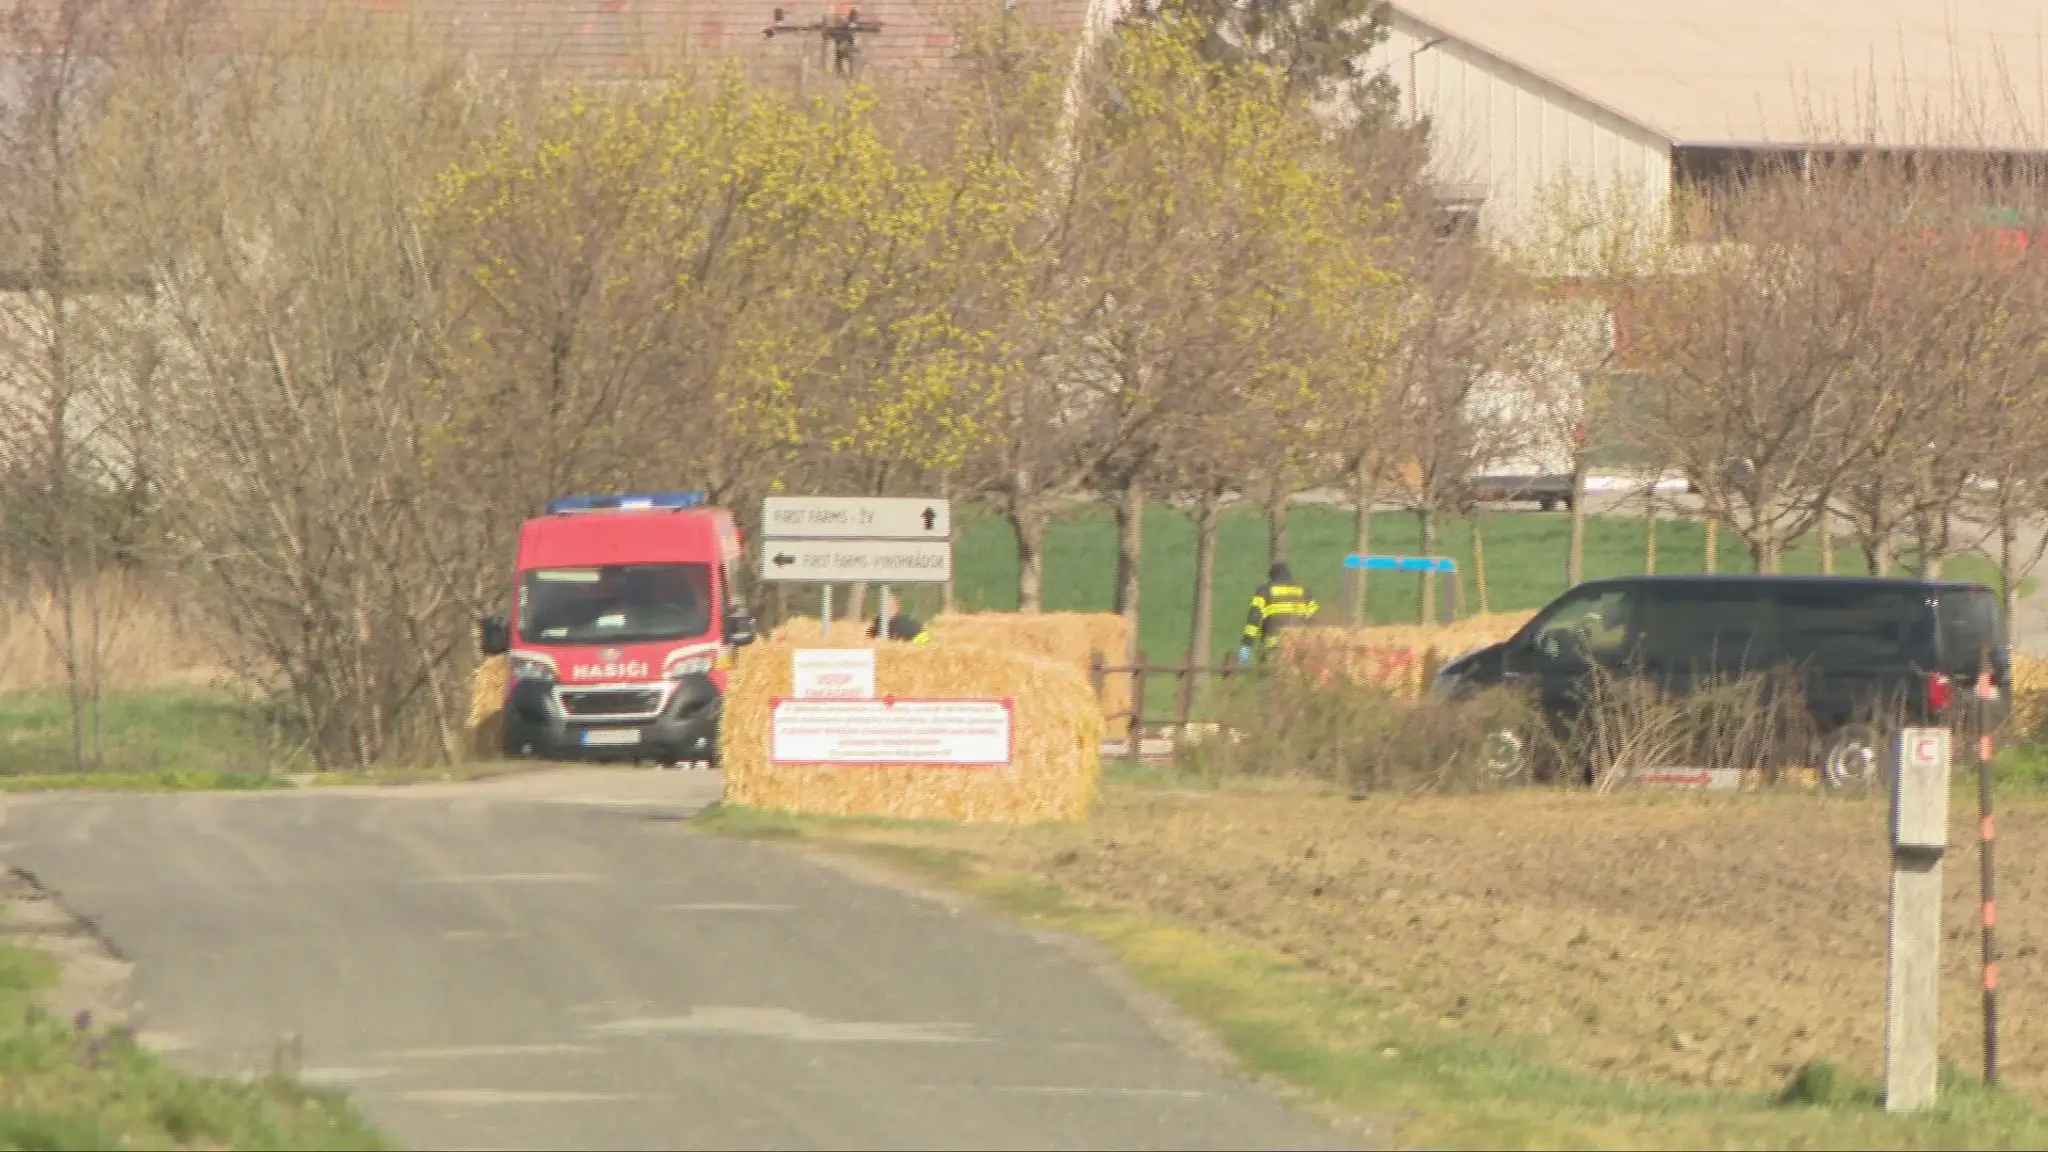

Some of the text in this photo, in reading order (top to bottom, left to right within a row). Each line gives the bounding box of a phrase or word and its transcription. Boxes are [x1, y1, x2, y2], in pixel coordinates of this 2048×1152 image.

[773, 509, 805, 524] FIRST
[808, 509, 847, 524] FARMS
[1915, 739, 1934, 761] C
